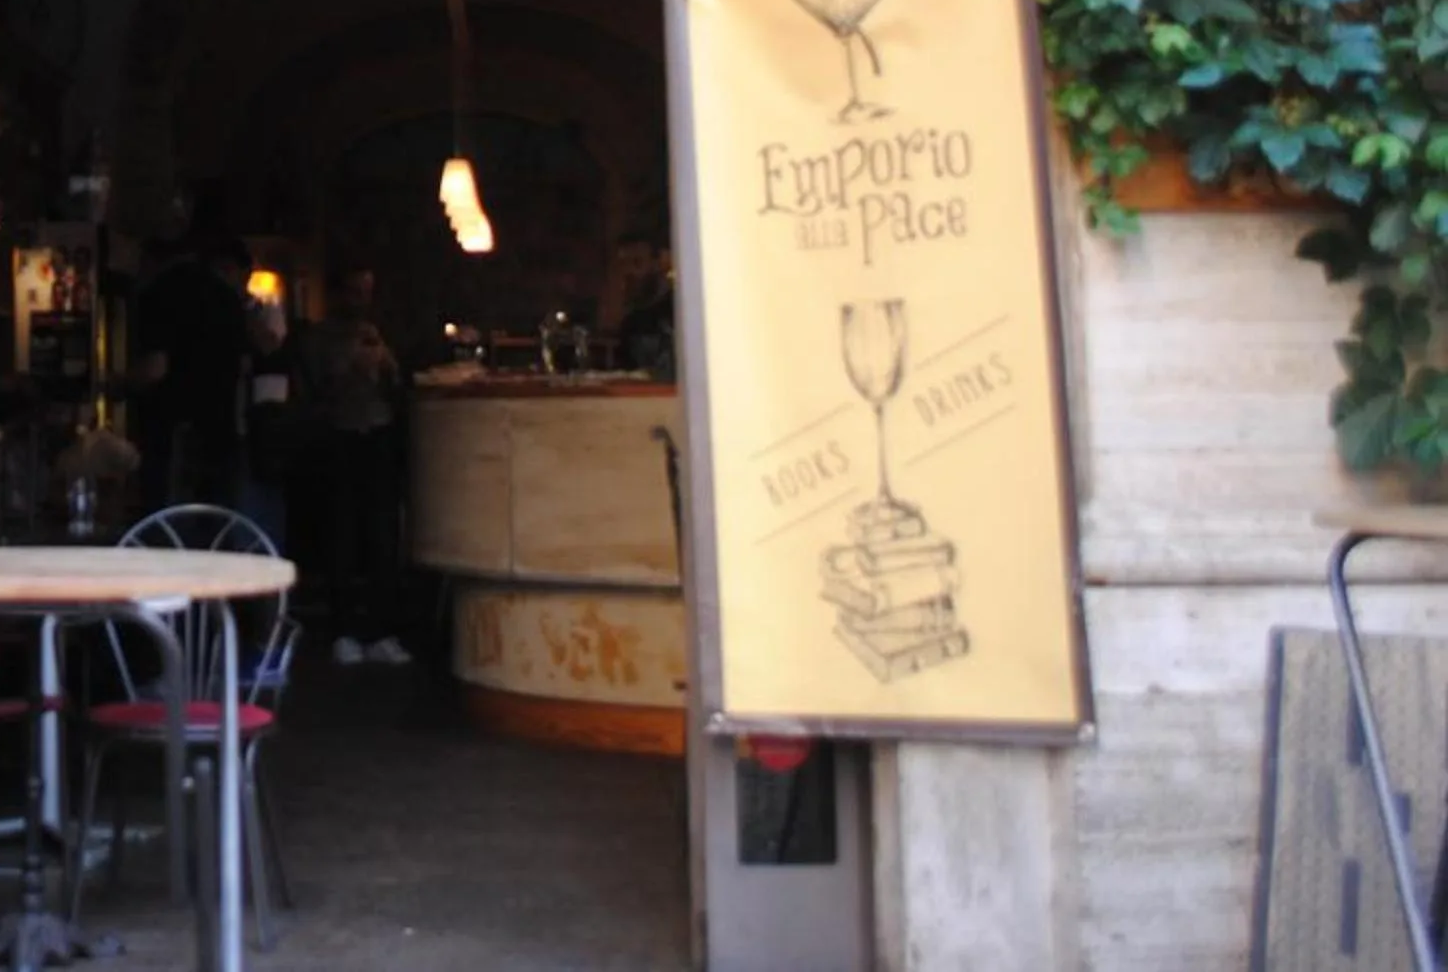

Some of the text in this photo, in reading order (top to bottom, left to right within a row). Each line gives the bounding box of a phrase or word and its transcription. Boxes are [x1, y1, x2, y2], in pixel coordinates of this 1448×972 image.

[757, 128, 973, 218] Emporio
[912, 352, 1014, 428] DRINKS
[762, 439, 850, 507] BOOKS
